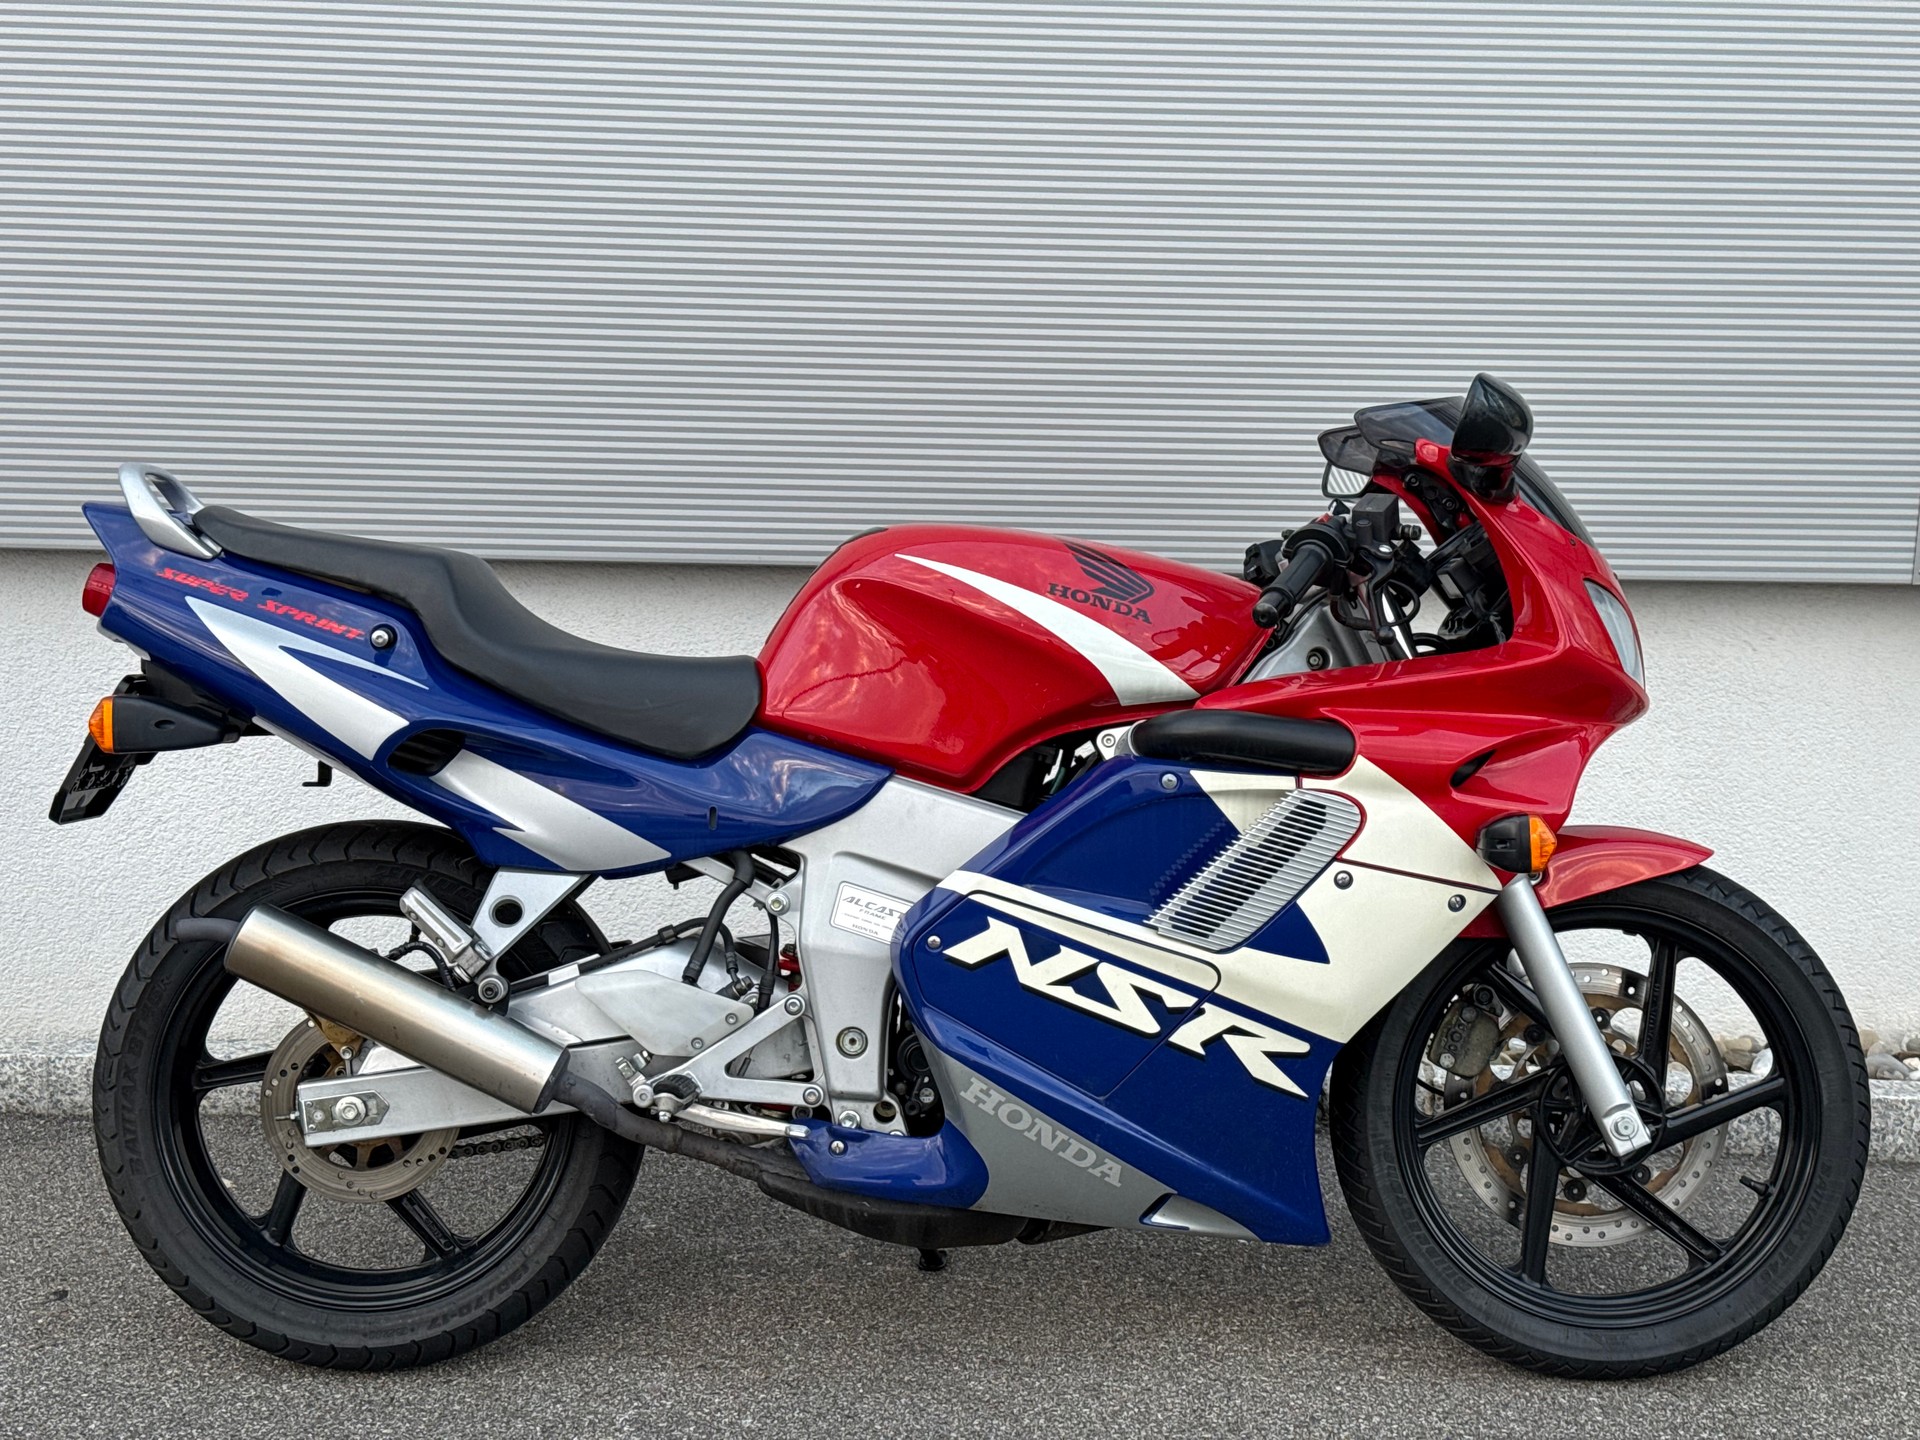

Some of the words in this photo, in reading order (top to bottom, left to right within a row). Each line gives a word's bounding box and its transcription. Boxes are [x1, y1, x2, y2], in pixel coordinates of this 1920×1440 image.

[156, 567, 249, 601] SUPER
[257, 599, 365, 639] SPRINT
[1047, 582, 1152, 624] HONDA
[852, 923, 879, 936] HONDA
[859, 908, 887, 921] FRAME
[942, 916, 1310, 1099] NSR
[959, 1076, 1122, 1188] HONDA
